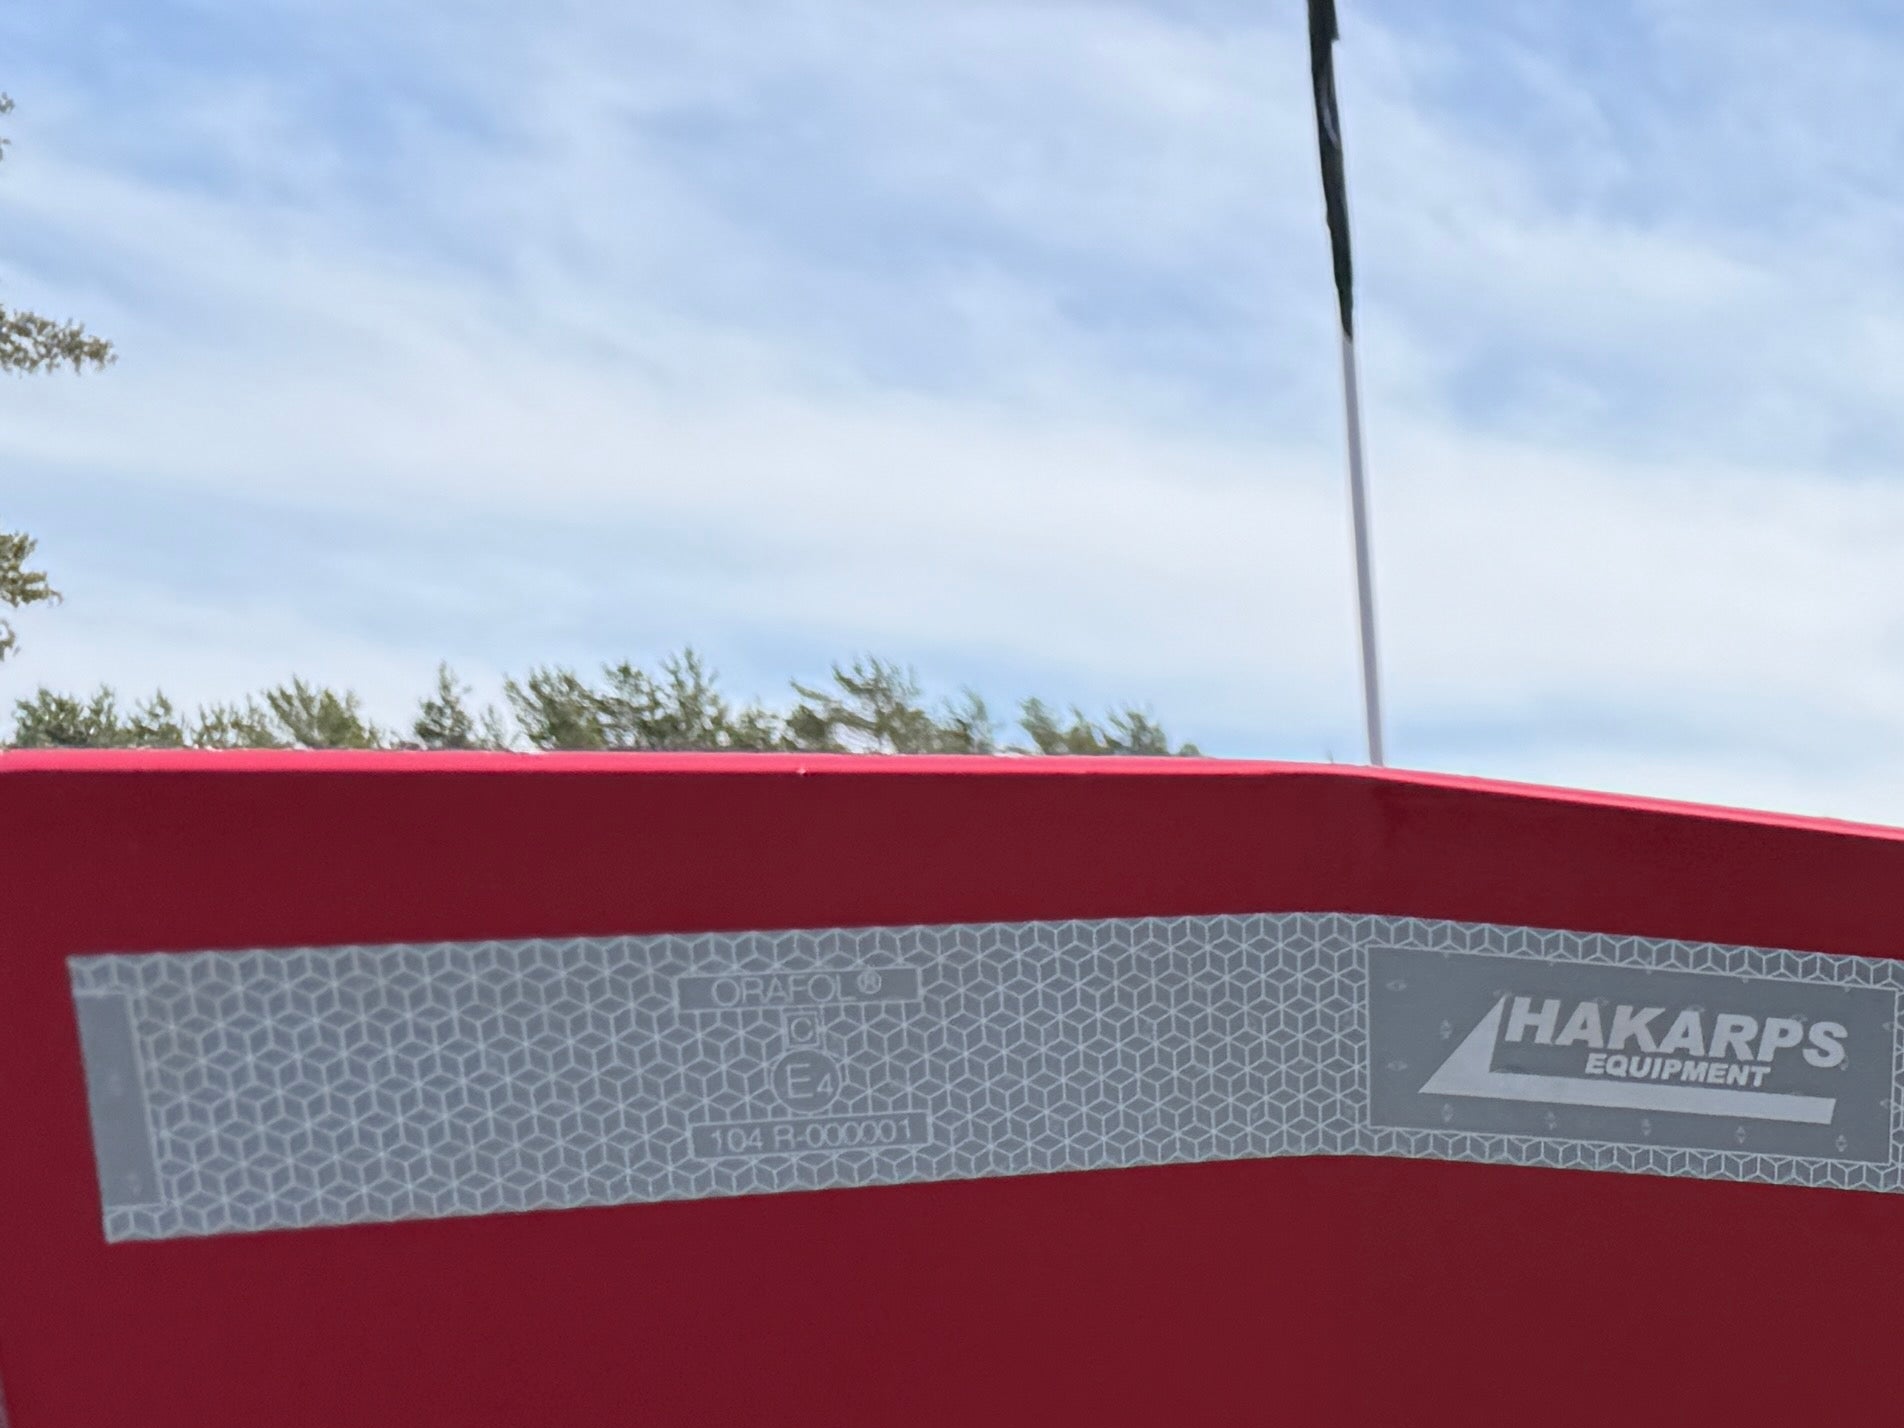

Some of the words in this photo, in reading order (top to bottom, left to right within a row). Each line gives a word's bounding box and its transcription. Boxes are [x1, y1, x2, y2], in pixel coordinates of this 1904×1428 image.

[1505, 996, 1849, 1069] HAKARPS
[1585, 1053, 1772, 1088] EQUIPMENT
[711, 1128, 764, 1152] 104
